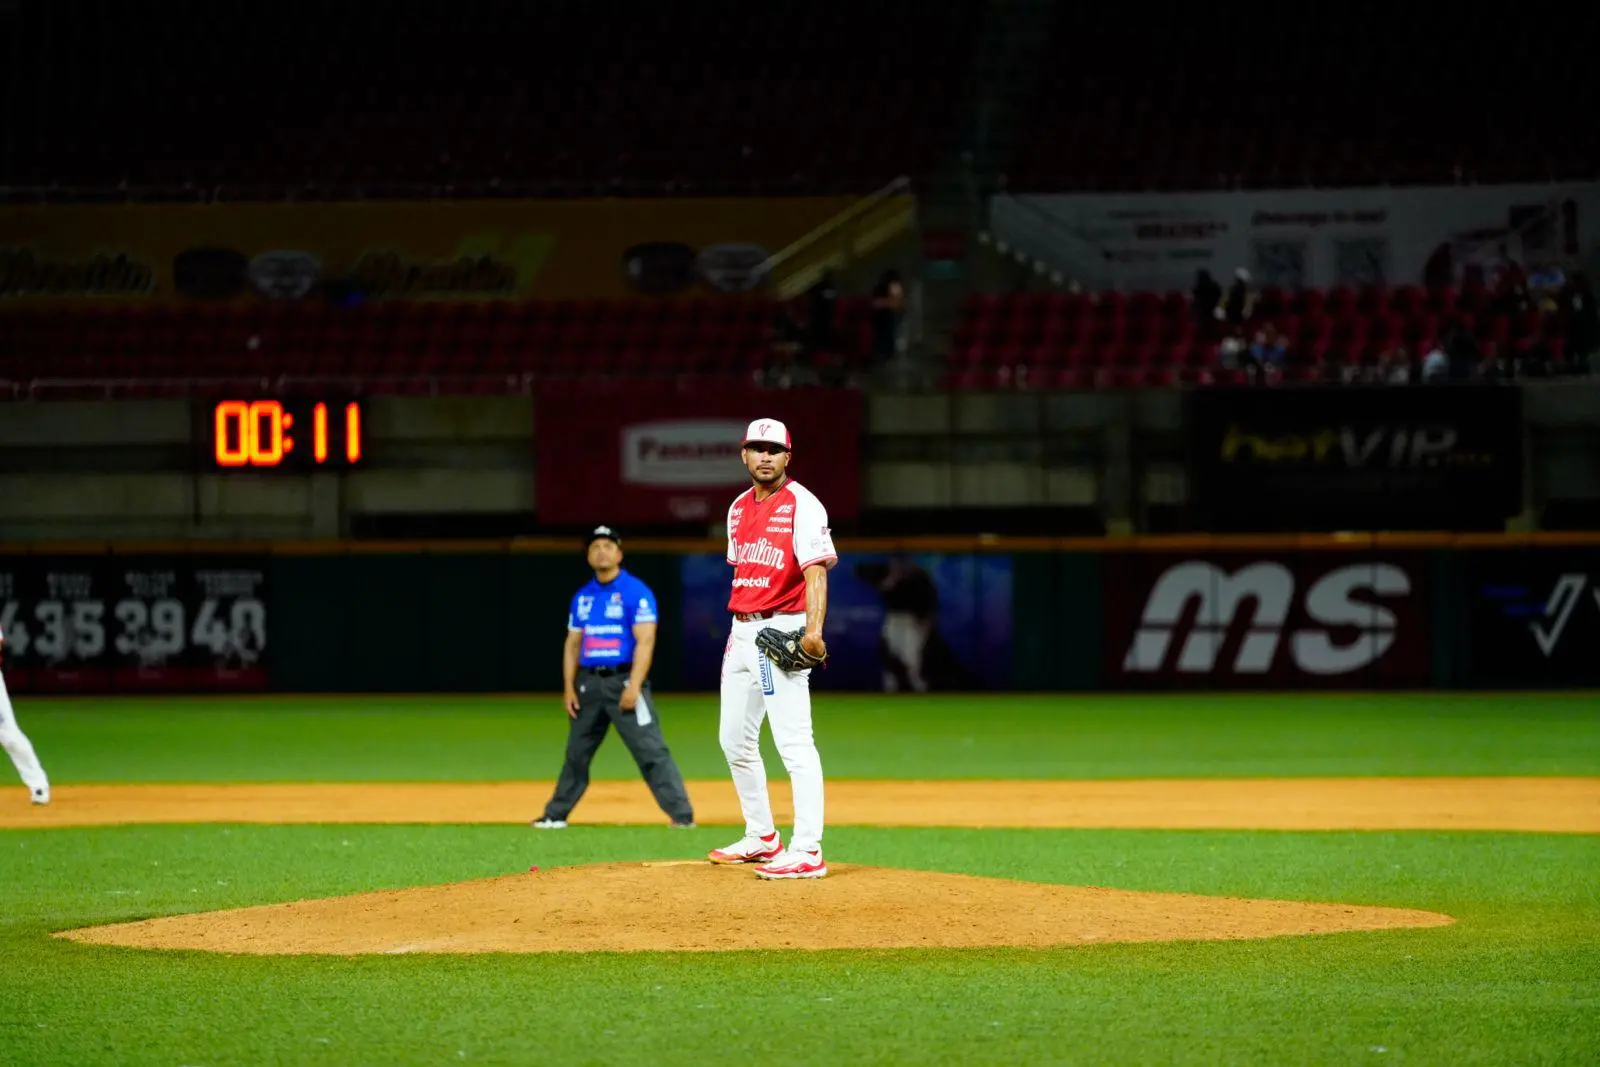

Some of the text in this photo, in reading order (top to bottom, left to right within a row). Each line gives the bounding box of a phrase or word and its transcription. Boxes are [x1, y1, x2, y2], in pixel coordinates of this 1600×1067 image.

[213, 400, 363, 467] 00:11
[33, 598, 107, 659] 35
[113, 597, 187, 658] 39
[190, 597, 267, 657] 40
